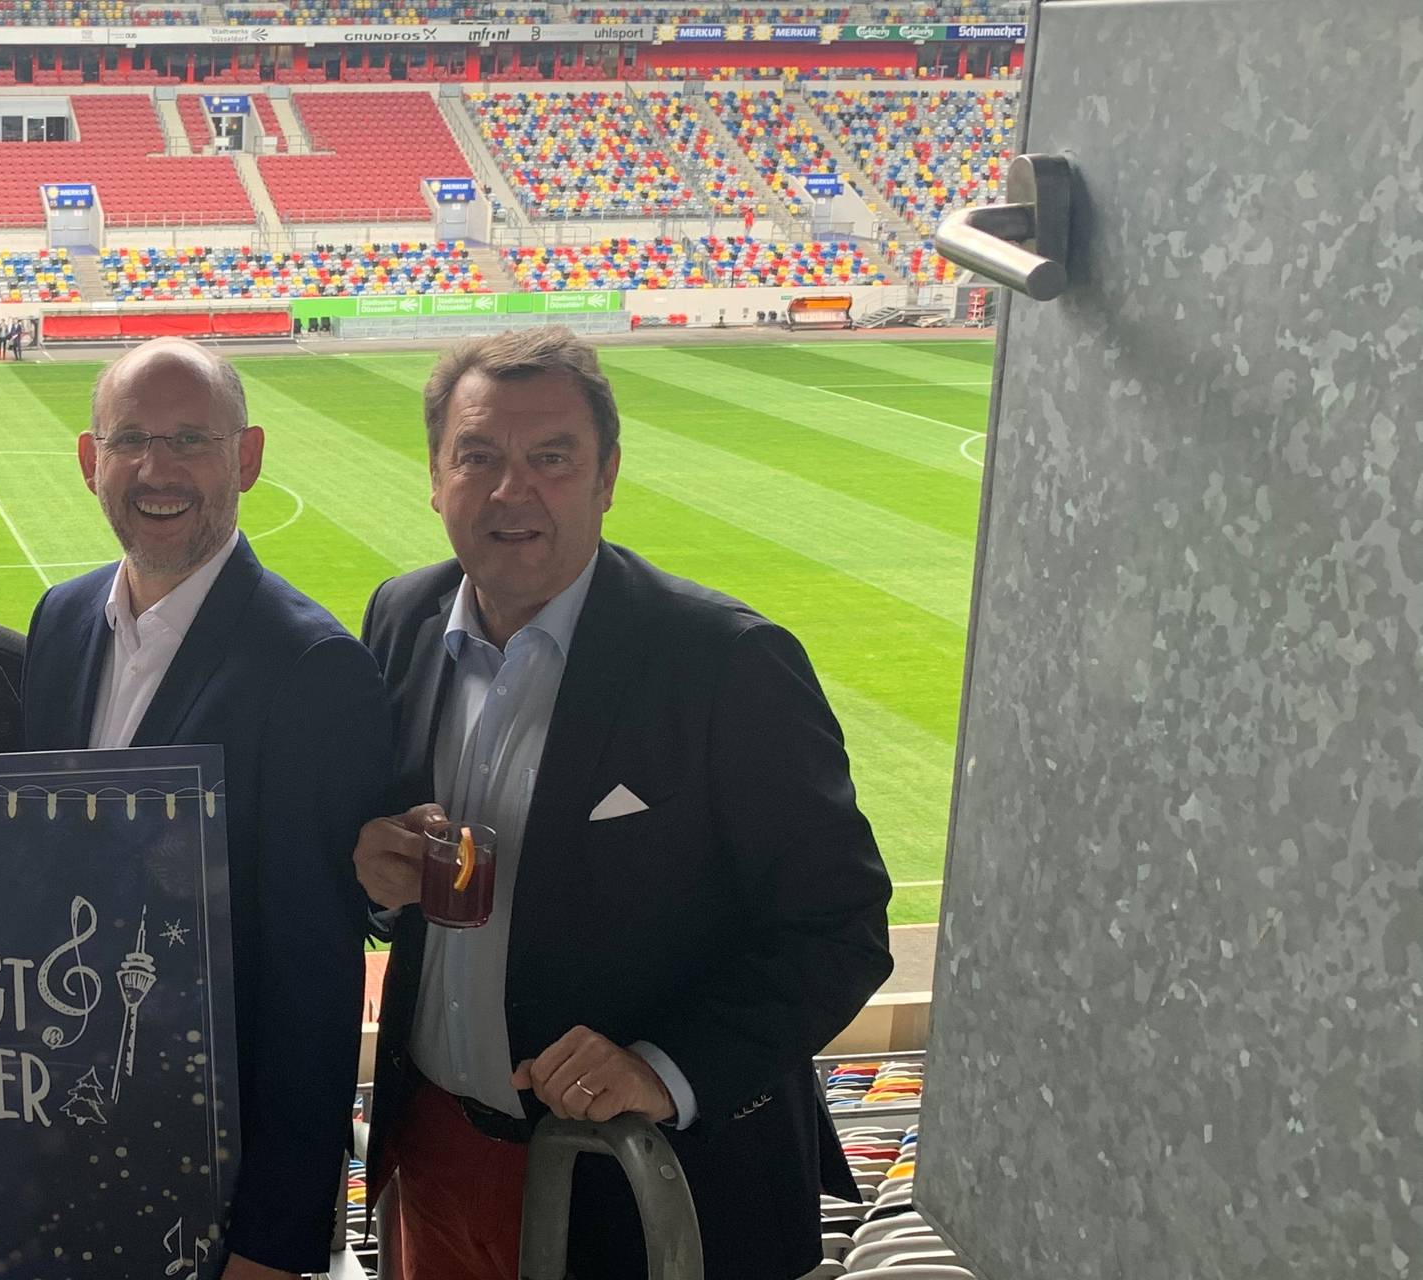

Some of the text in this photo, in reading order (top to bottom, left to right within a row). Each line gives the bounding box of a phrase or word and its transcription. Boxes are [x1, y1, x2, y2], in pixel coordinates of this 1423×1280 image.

[344, 32, 421, 41] GRUNDFOS
[594, 27, 644, 40] uhlsport
[680, 28, 722, 38] MERKUR
[776, 28, 816, 37] MERKUR
[856, 26, 890, 39] Carlsberg
[899, 26, 934, 39] Carlsberg
[958, 25, 1022, 38] Schumacher
